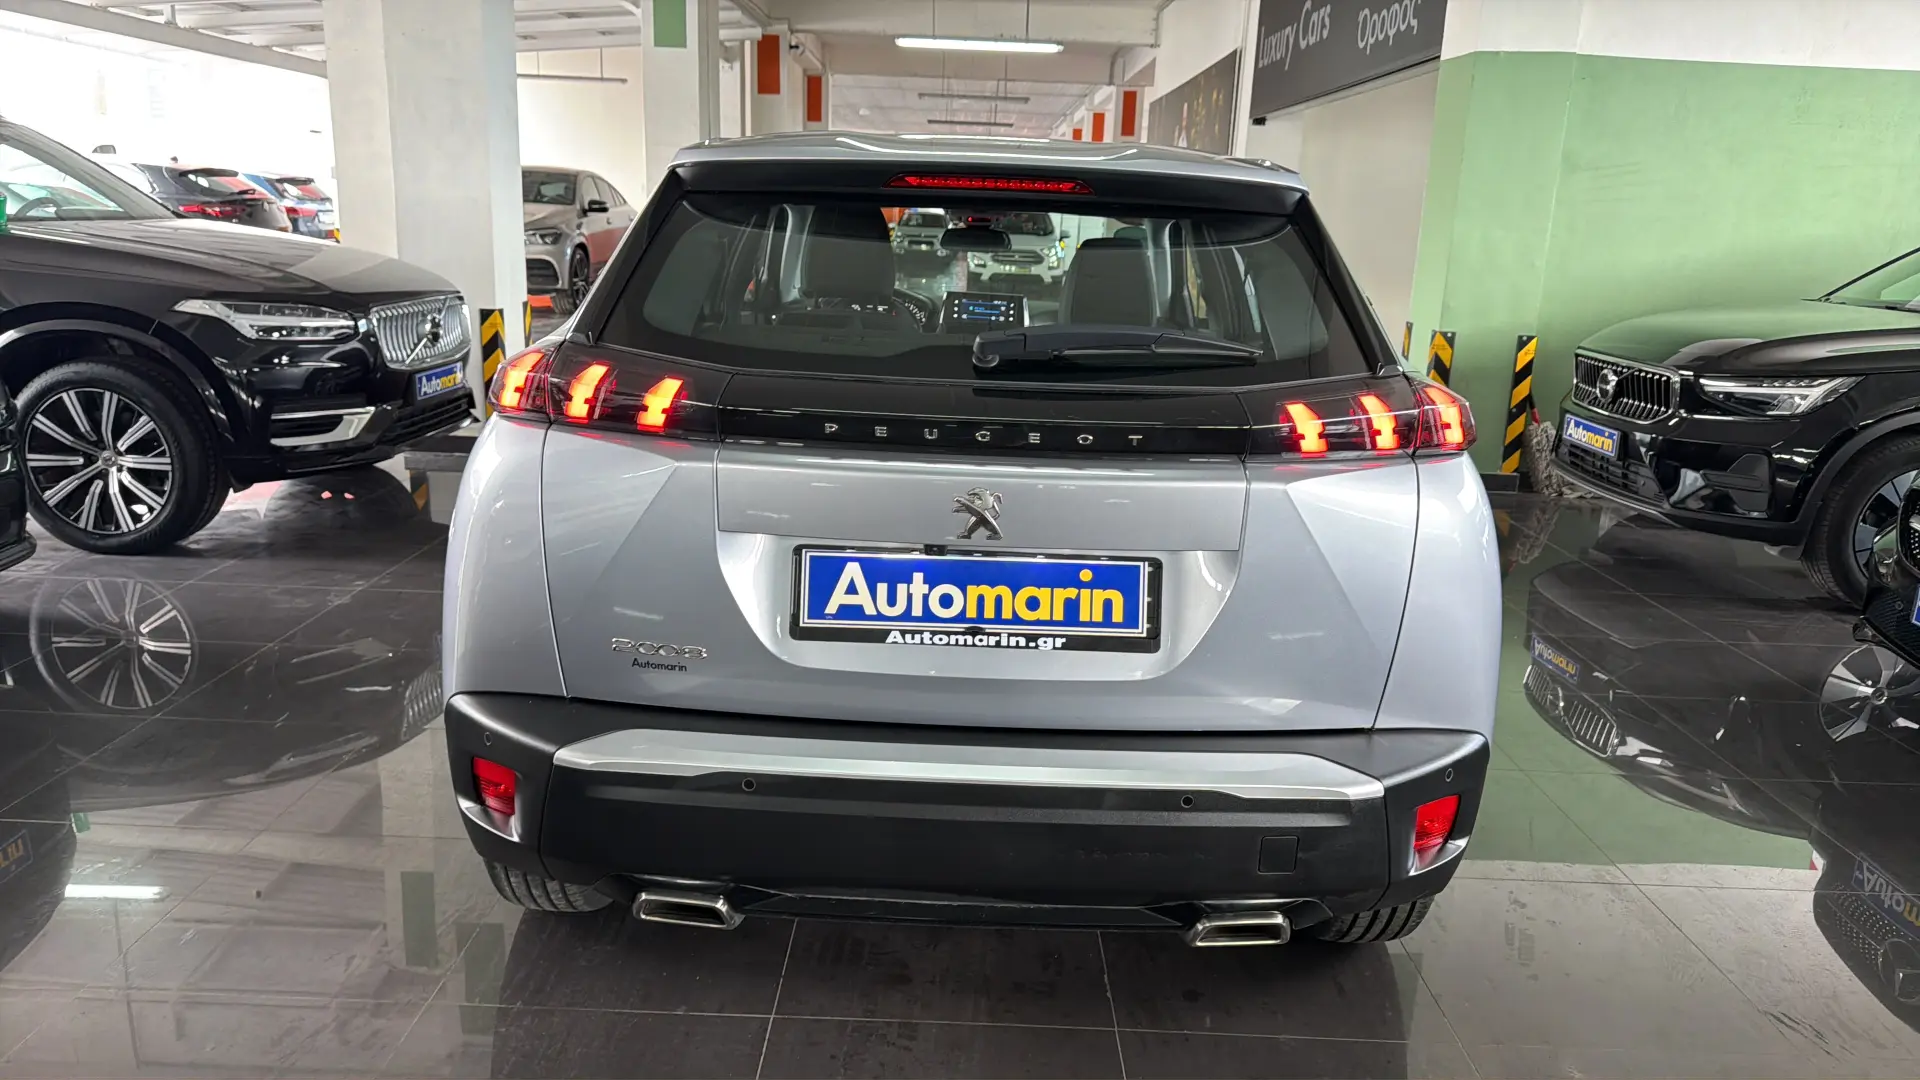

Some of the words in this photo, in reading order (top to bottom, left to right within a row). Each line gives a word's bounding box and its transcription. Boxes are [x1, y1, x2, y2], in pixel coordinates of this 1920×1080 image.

[1258, 22, 1297, 71] Luxury
[1300, 0, 1331, 49] Cars
[824, 423, 1143, 447] PEUGEOT
[1566, 418, 1613, 452] Automarin
[824, 561, 1124, 623] Automarin
[611, 637, 708, 660] 2008
[885, 630, 1066, 650] Automarin.gr
[631, 657, 688, 672] Automarin
